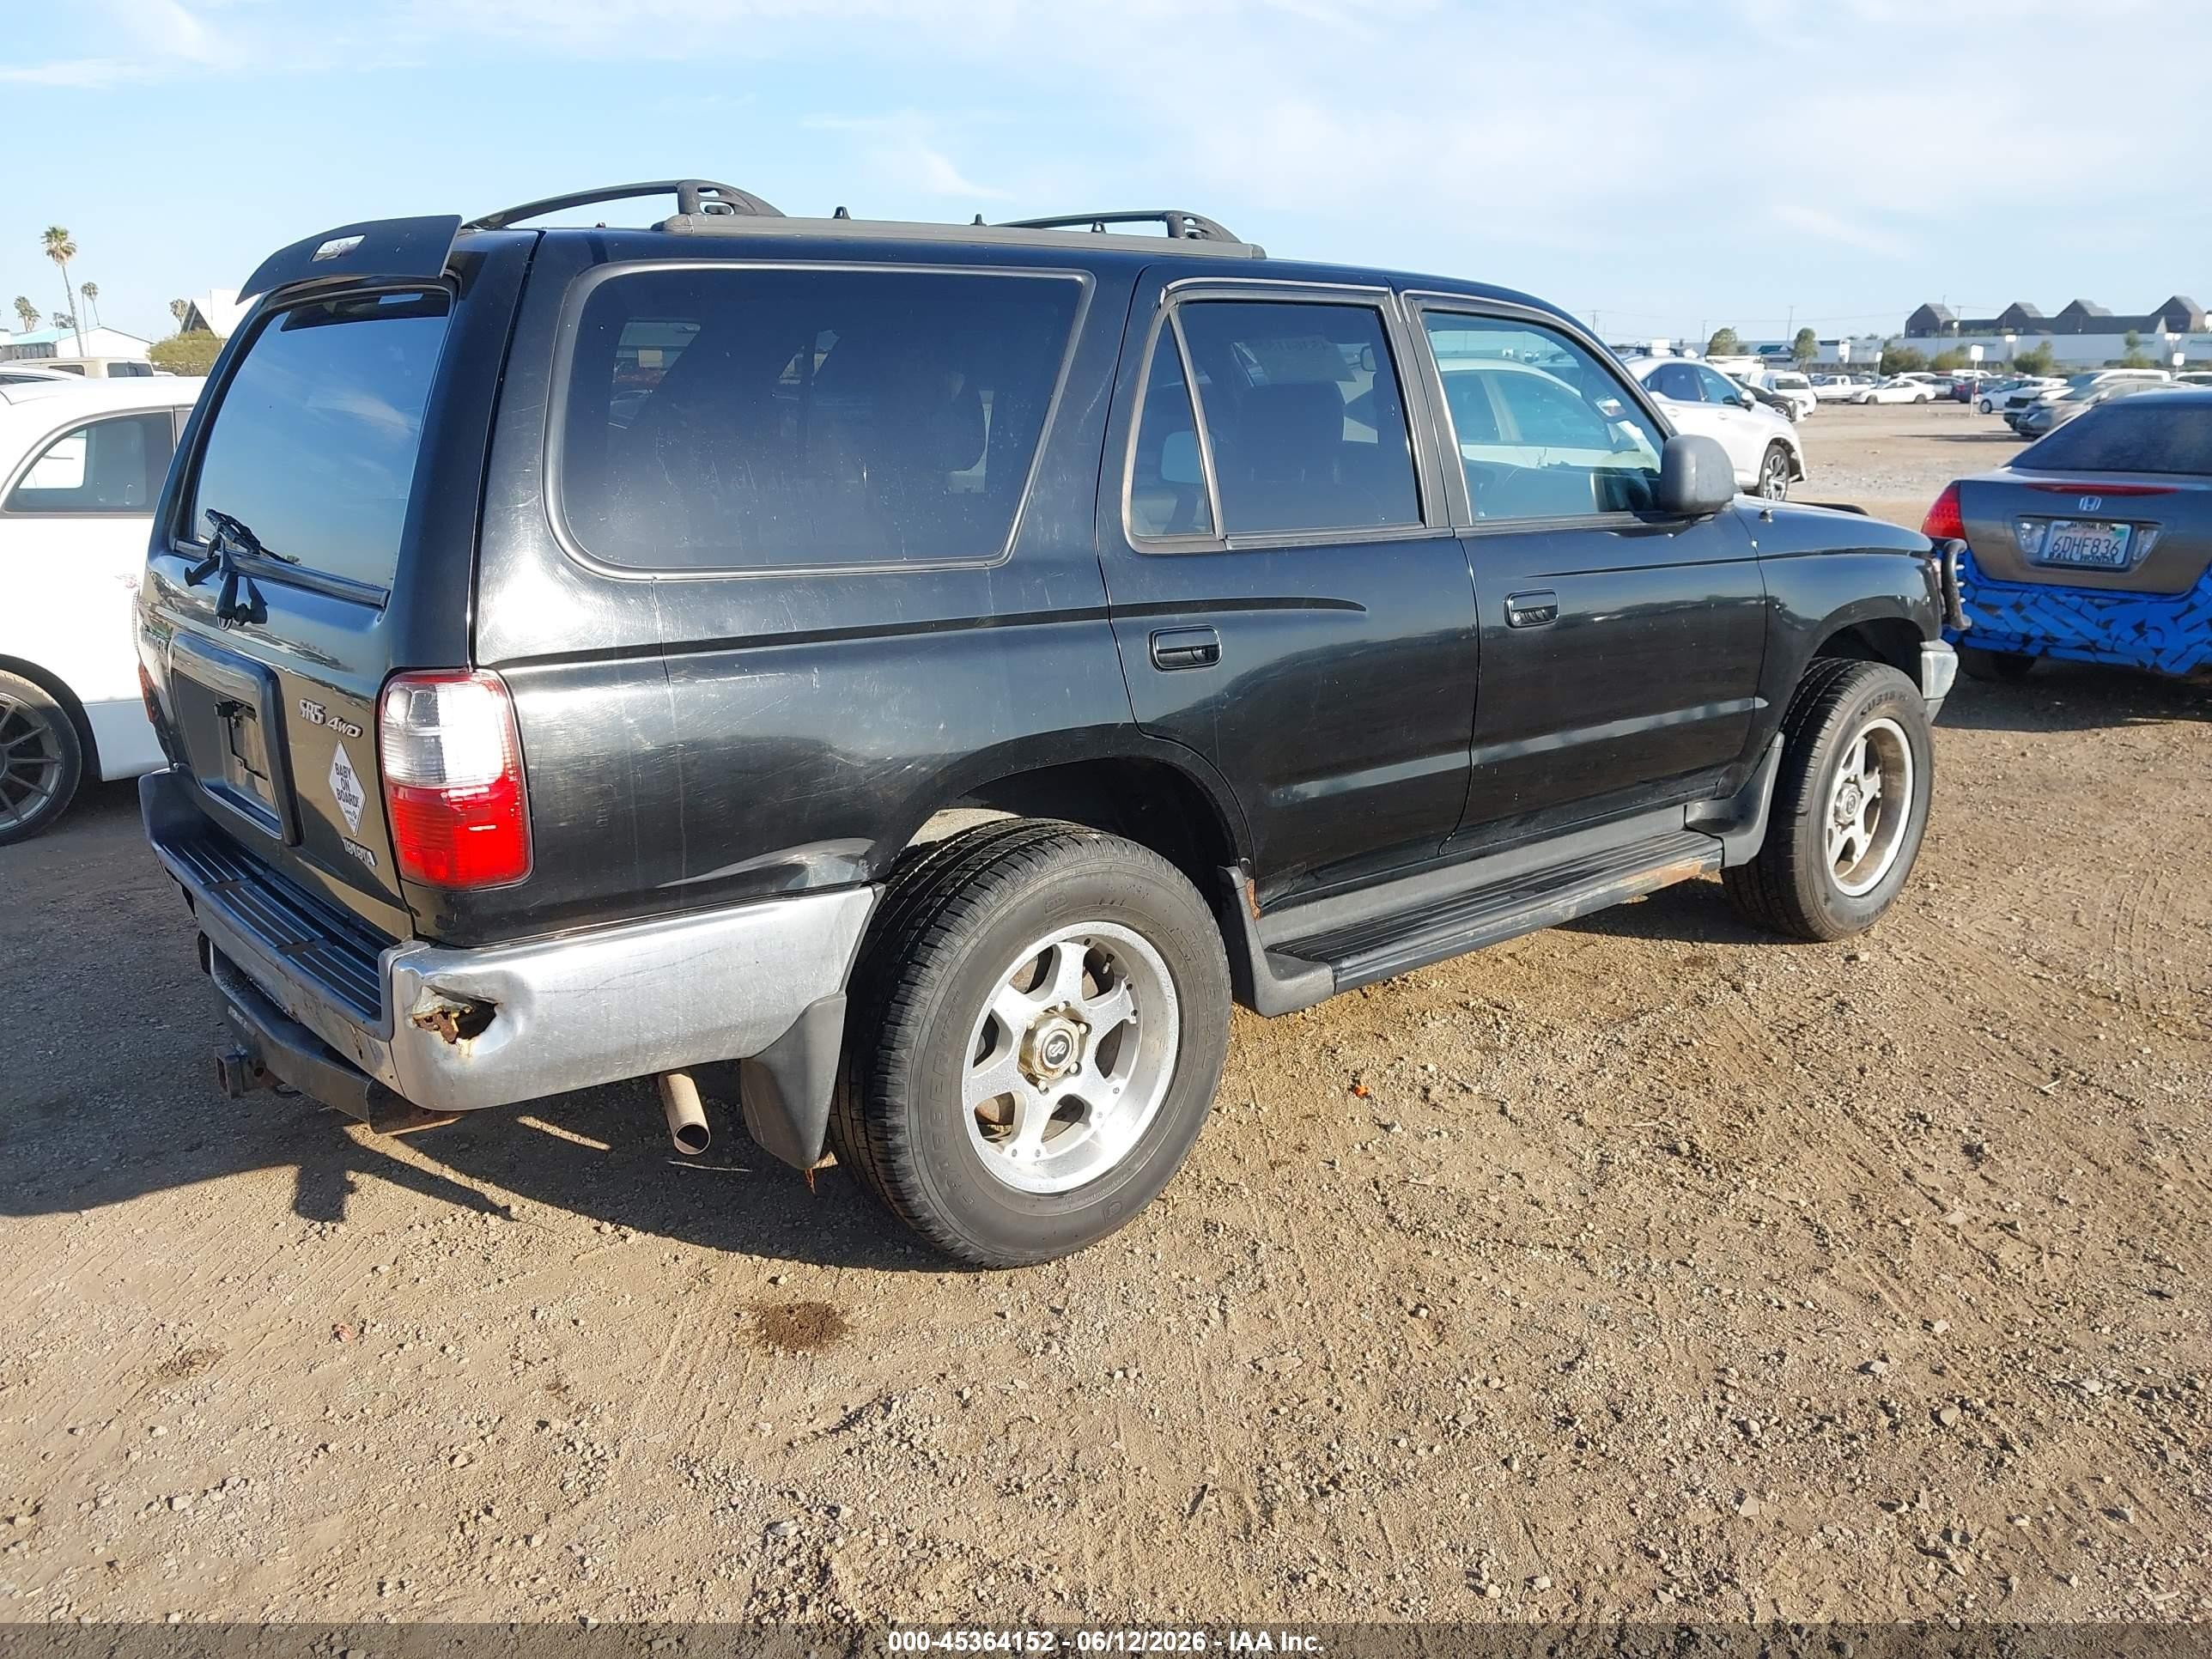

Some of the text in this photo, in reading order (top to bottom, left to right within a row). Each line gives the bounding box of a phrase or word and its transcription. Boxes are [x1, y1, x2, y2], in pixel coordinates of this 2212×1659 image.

[2079, 554, 2116, 564] HONDA
[327, 716, 363, 738] 4WD
[335, 762, 351, 780] BABY
[340, 777, 350, 793] ON
[342, 837, 378, 866] TOYOTA
